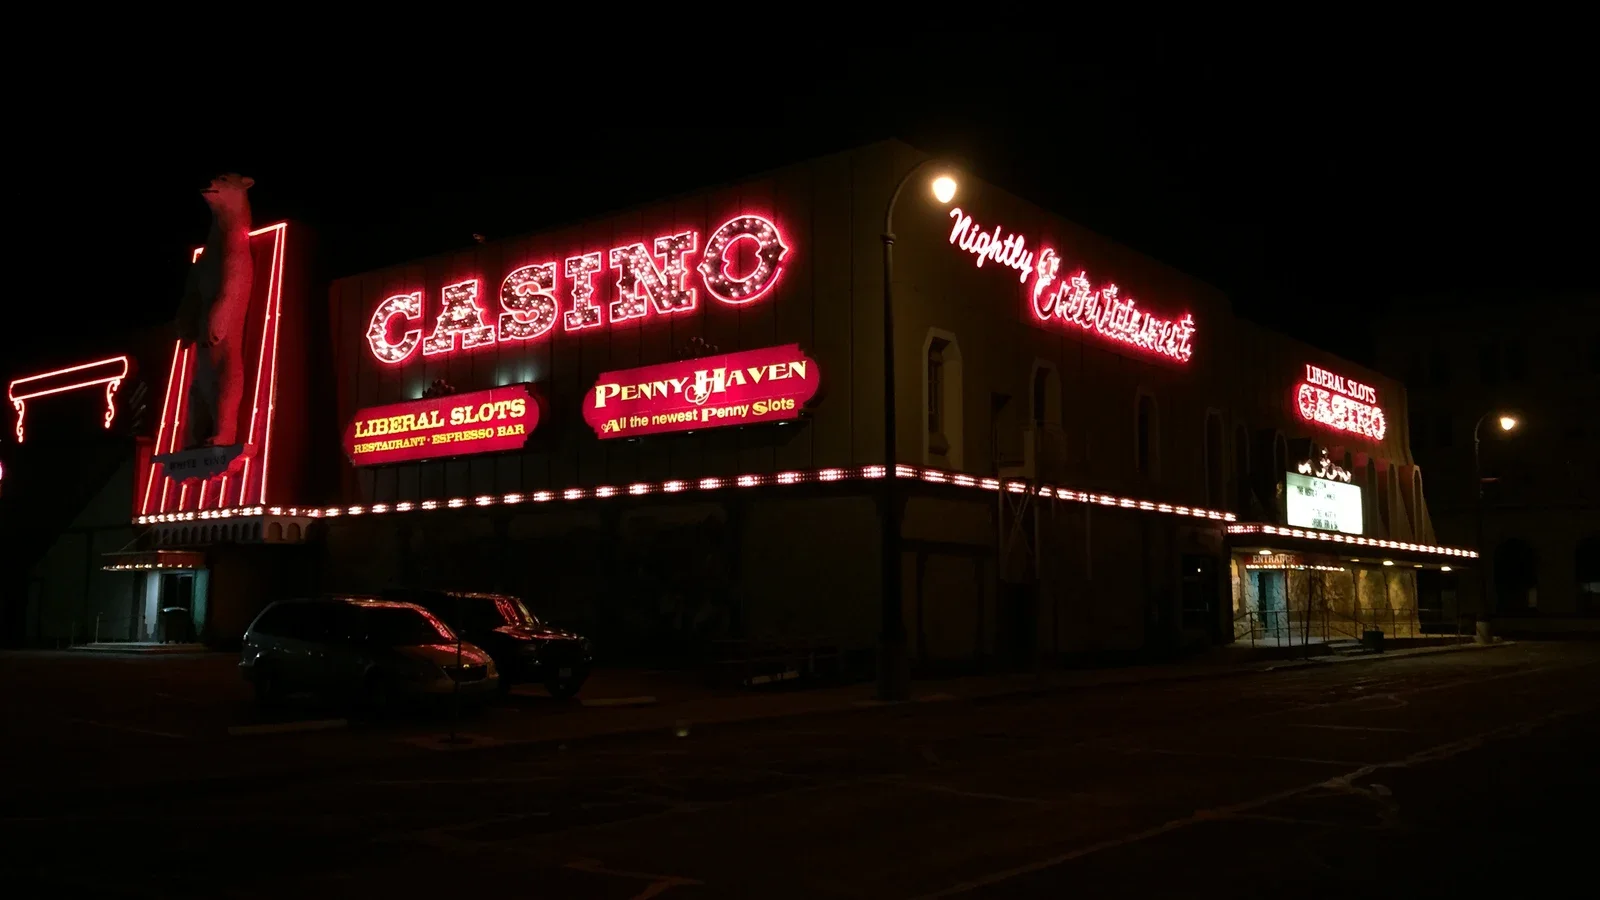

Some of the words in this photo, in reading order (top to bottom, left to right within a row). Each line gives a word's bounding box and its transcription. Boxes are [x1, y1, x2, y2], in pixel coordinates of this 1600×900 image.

[949, 207, 1033, 284] Nightly
[366, 215, 789, 364] CASINO
[593, 377, 689, 408] PENNY
[685, 360, 807, 405] HAVEN
[1306, 364, 1347, 394] LIBERAL
[1348, 379, 1377, 404] SLOTS
[354, 410, 445, 438] LIBERAL
[450, 398, 526, 425] SLOTS
[601, 417, 626, 433] All
[630, 414, 649, 428] the
[651, 409, 698, 426] newest
[701, 404, 749, 422] Penny
[752, 397, 795, 416] Slots
[1298, 383, 1387, 441] CASINO
[354, 436, 426, 454] RESTAURANT
[432, 427, 494, 445] ESPRESSO
[497, 424, 525, 437] BAR
[1252, 553, 1296, 564] ENTRANCE
